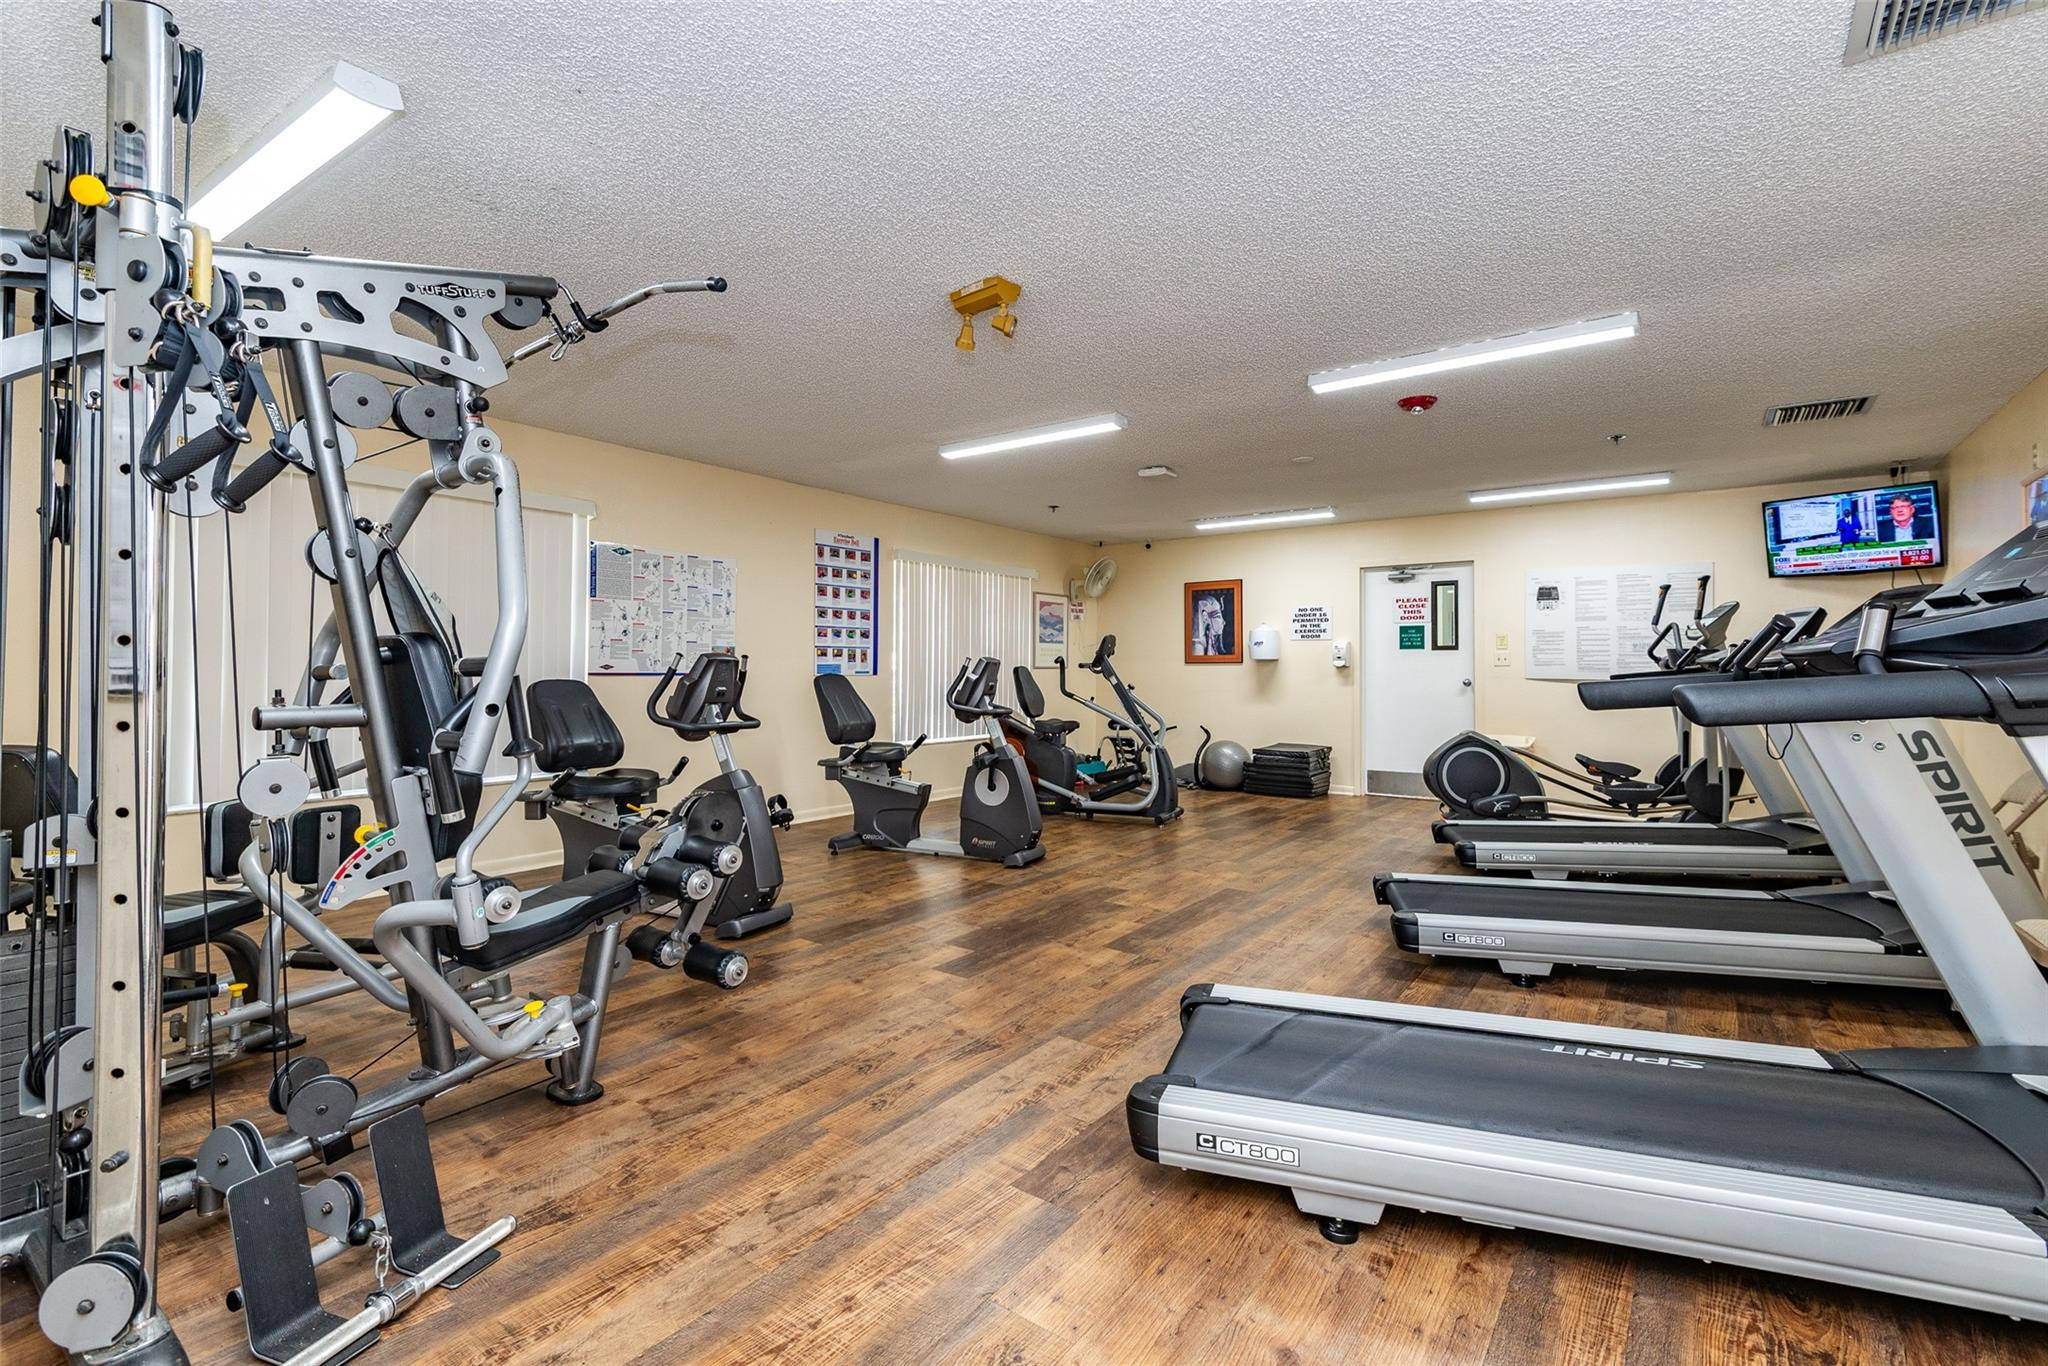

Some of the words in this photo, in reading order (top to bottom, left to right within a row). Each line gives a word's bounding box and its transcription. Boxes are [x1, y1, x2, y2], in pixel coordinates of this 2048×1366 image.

[416, 284, 486, 299] TUFFSTUFF
[1897, 729, 2015, 877] SPIRIT
[1457, 935, 1504, 946] CT800
[1541, 1045, 1707, 1069] SPIRIT
[1199, 1134, 1214, 1148] C
[1220, 1139, 1296, 1164] CT800
